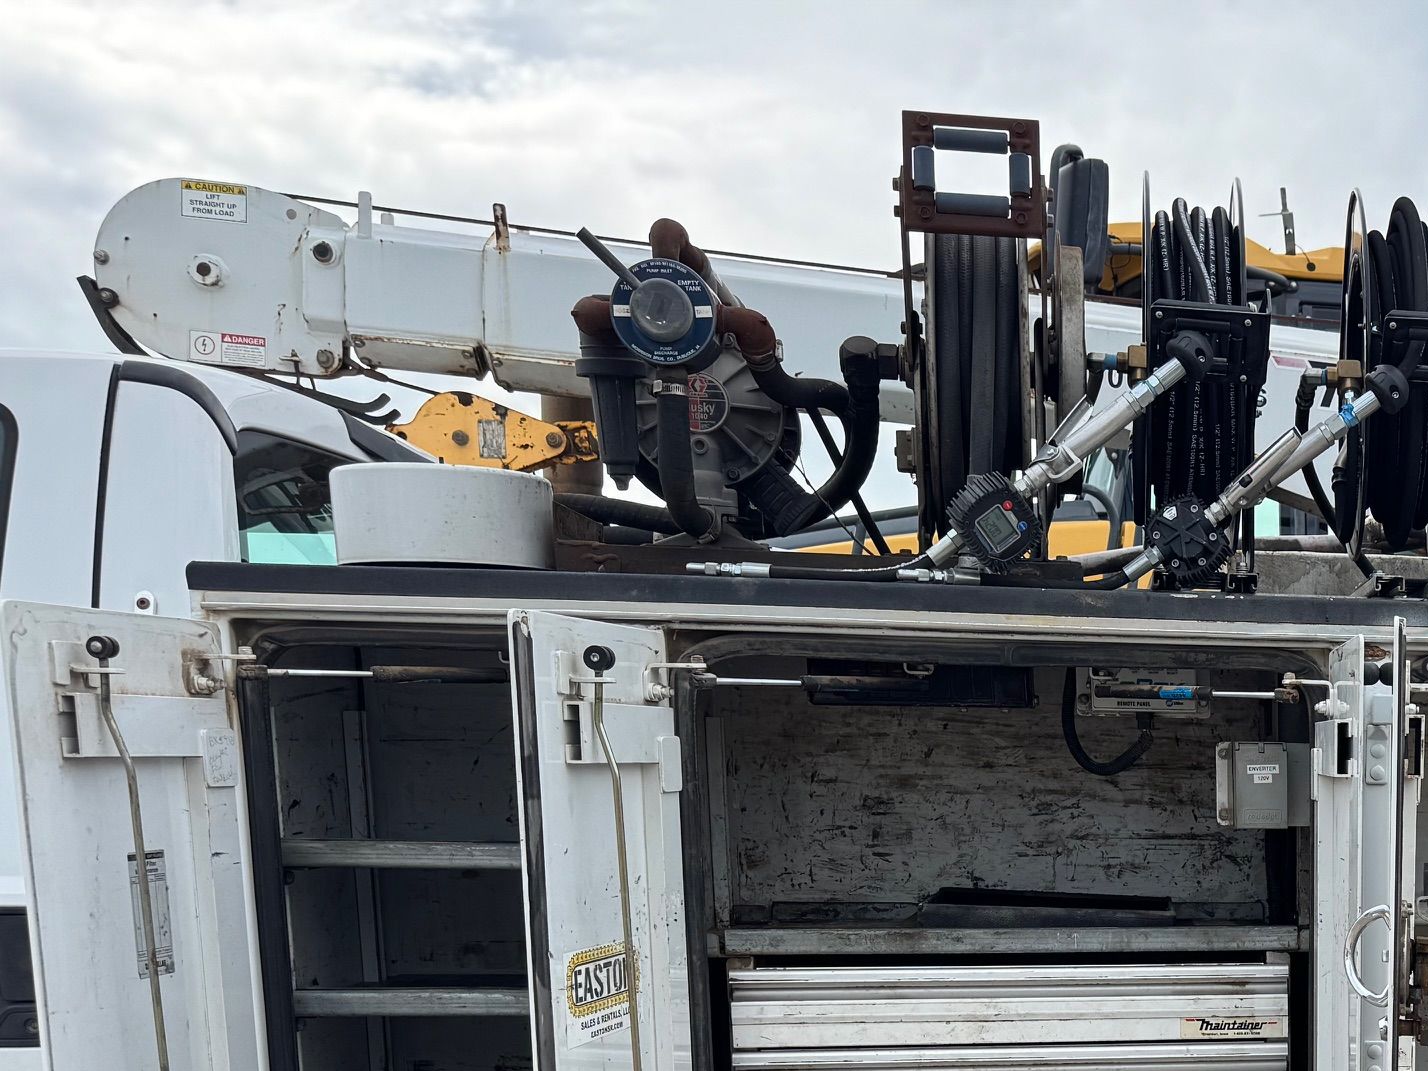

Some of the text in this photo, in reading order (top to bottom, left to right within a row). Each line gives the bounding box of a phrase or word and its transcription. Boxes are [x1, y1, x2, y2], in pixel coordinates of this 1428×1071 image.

[195, 183, 235, 194] CAUTION
[189, 199, 225, 209] STRAIGHT
[214, 209, 235, 217] LOAD
[232, 336, 265, 346] DANGER
[691, 402, 715, 416] usky
[580, 1018, 596, 1031] SALES
[1196, 1018, 1268, 1031] Maintainer
